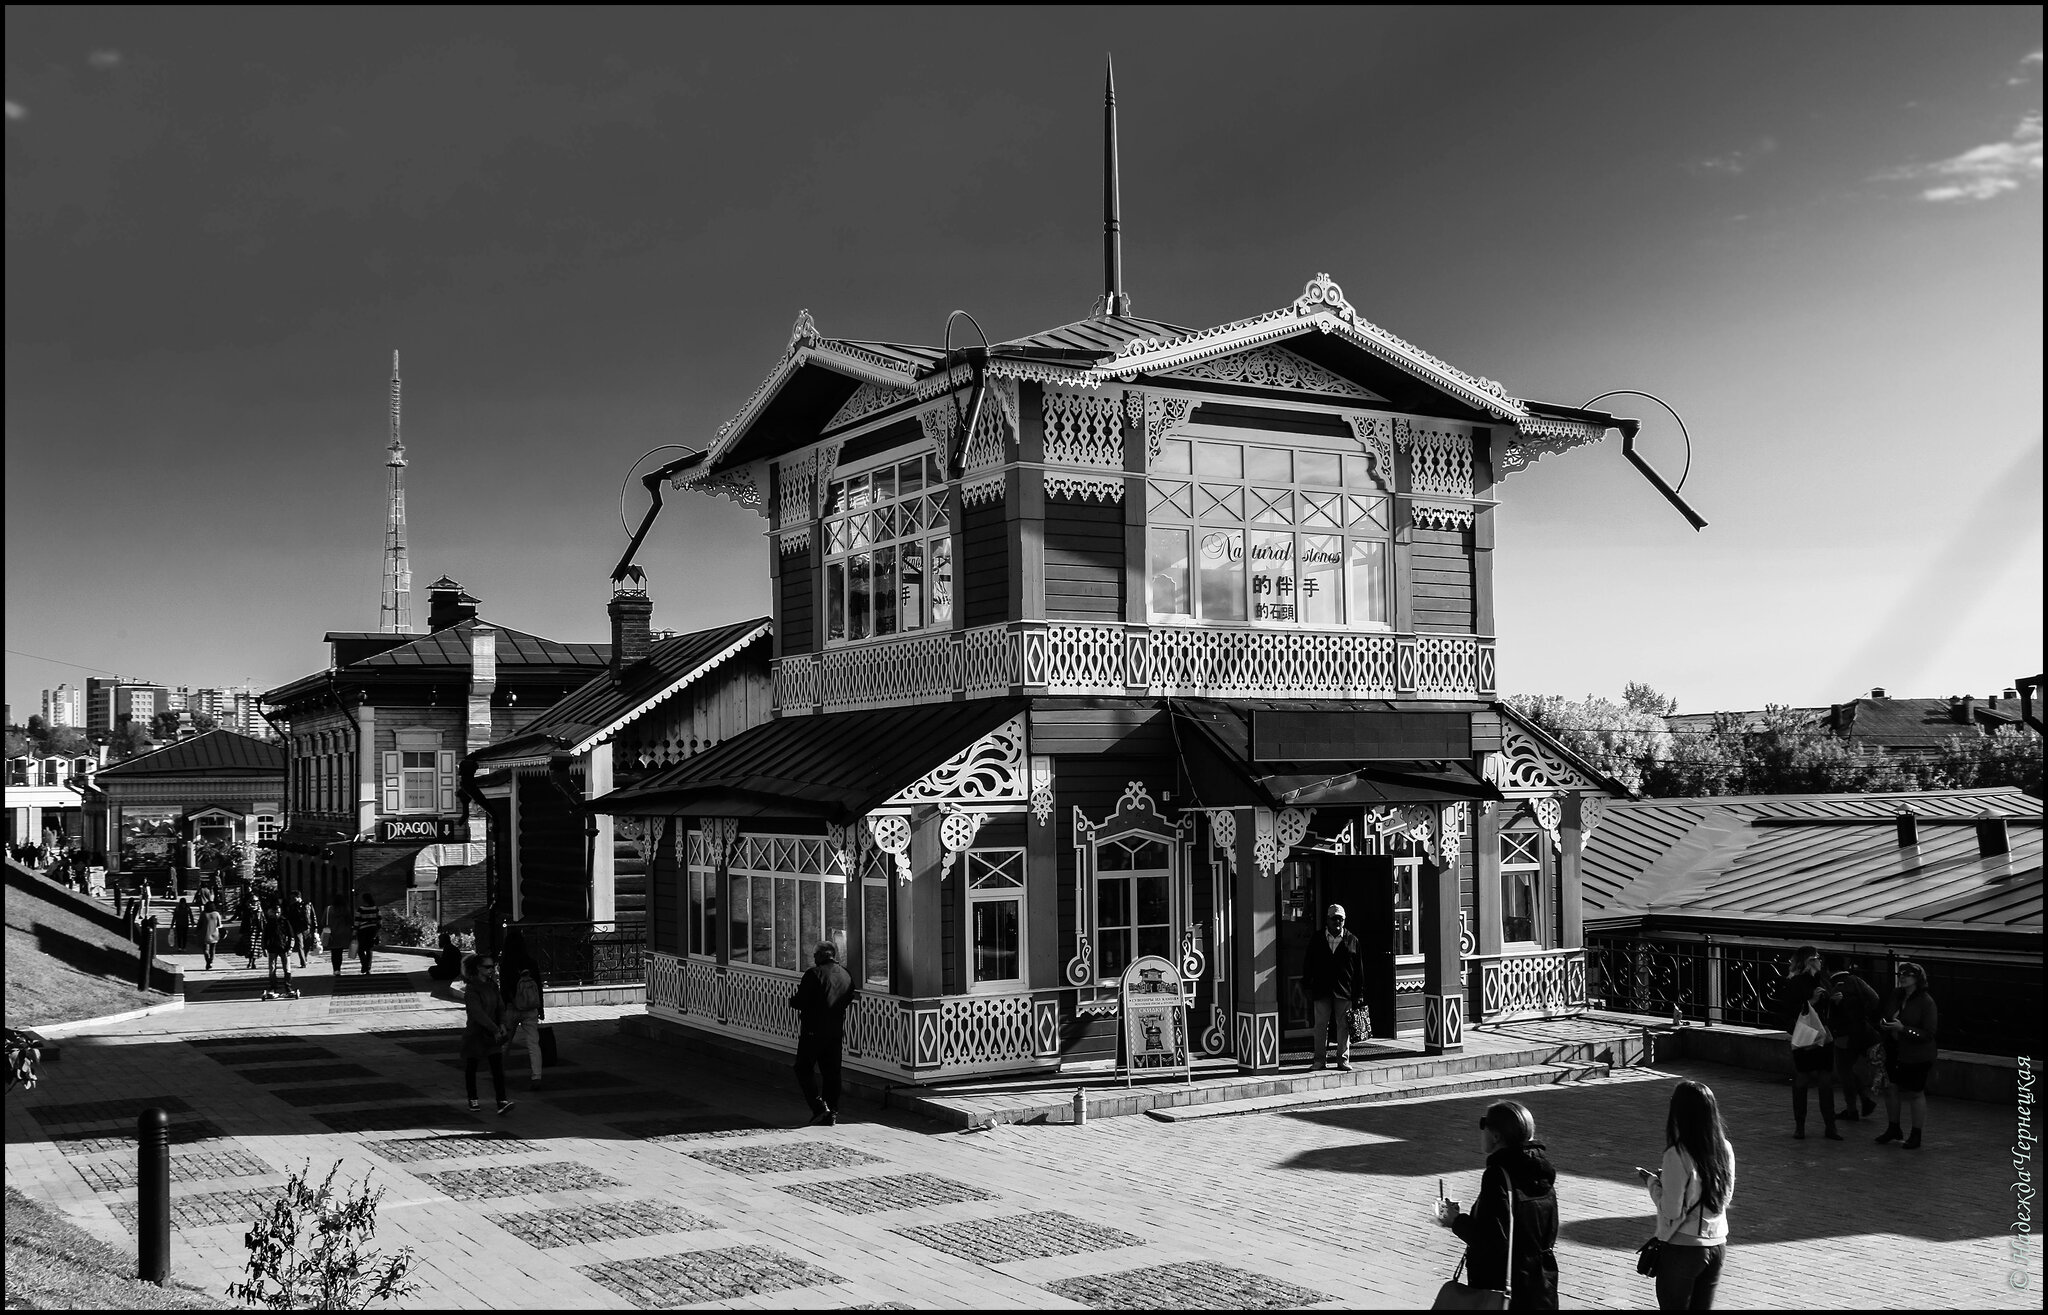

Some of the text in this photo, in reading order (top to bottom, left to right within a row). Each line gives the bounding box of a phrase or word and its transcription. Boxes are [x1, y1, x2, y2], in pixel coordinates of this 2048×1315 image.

[1201, 532, 1342, 564] Natural stones
[1255, 603, 1295, 620] 的石頭
[385, 821, 437, 840] DRAGON
